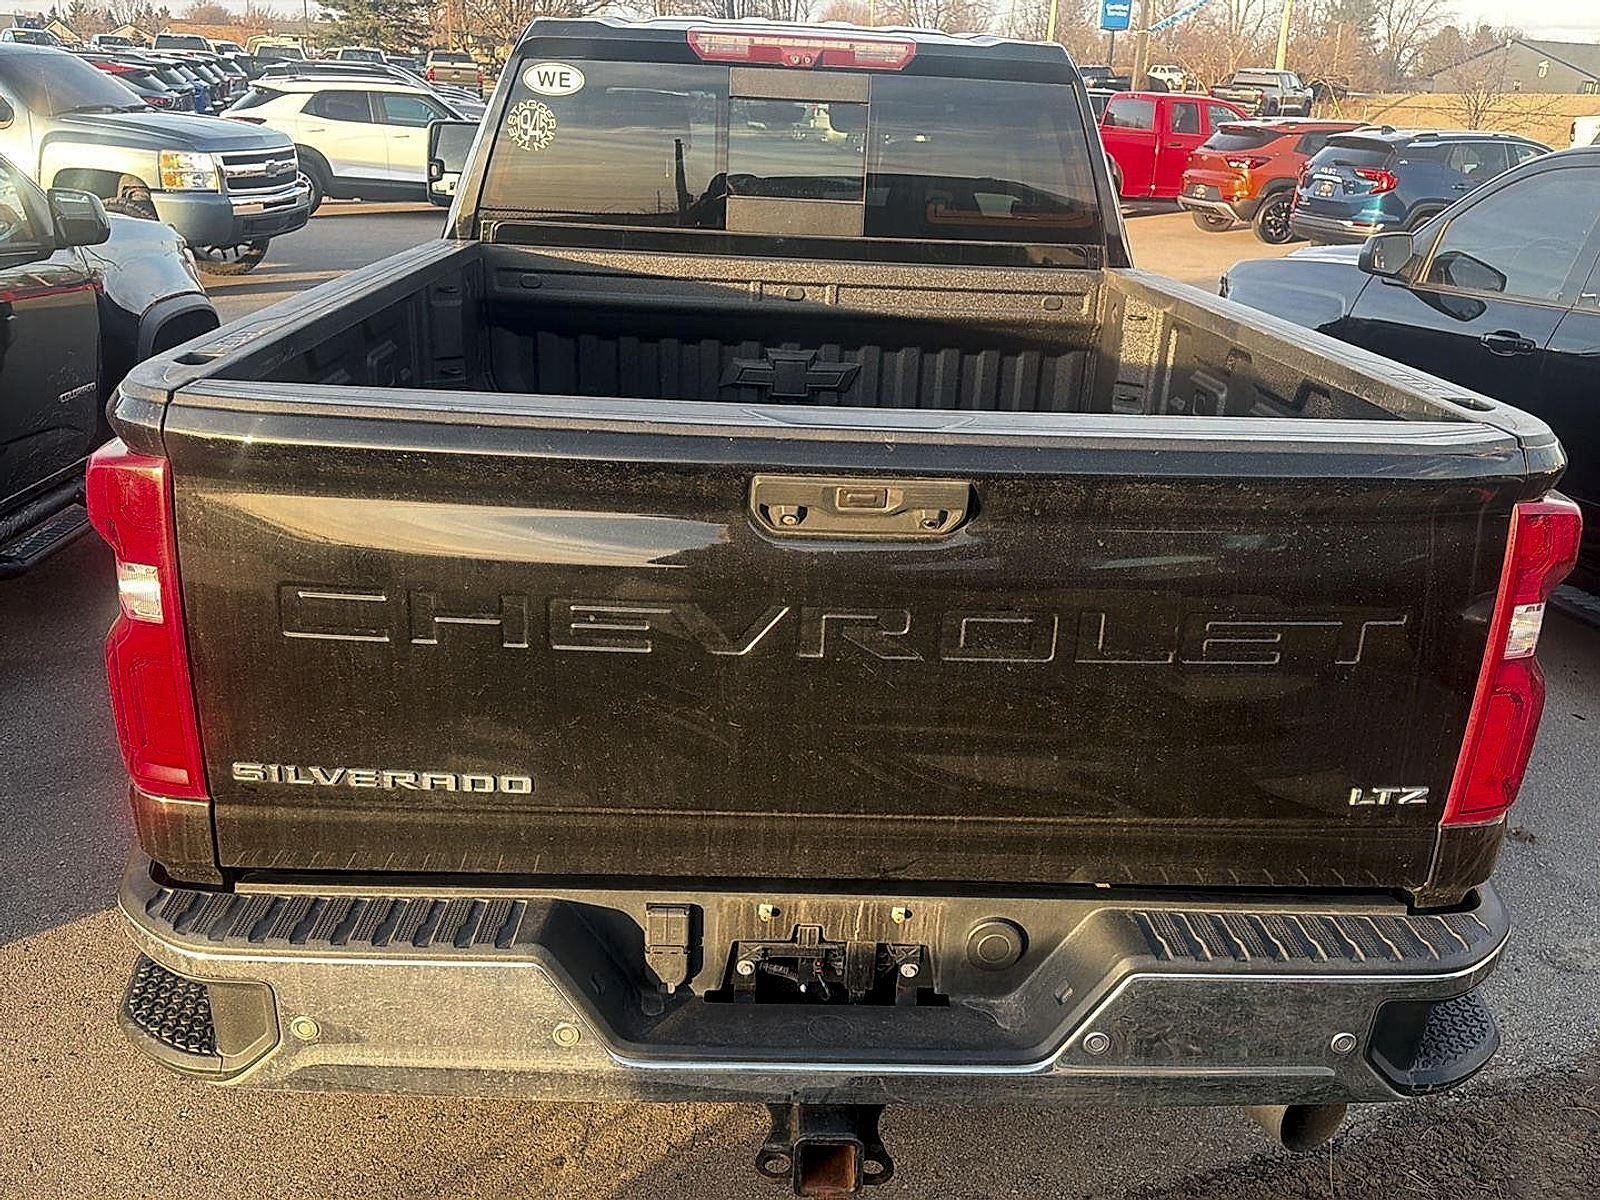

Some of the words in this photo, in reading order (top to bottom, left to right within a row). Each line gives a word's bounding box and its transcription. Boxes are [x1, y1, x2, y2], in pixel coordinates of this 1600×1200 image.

[538, 70, 571, 88] WE
[278, 581, 1408, 665] CHEVROLET
[232, 761, 534, 794] SILVERADO
[1349, 787, 1429, 806] LTZ
